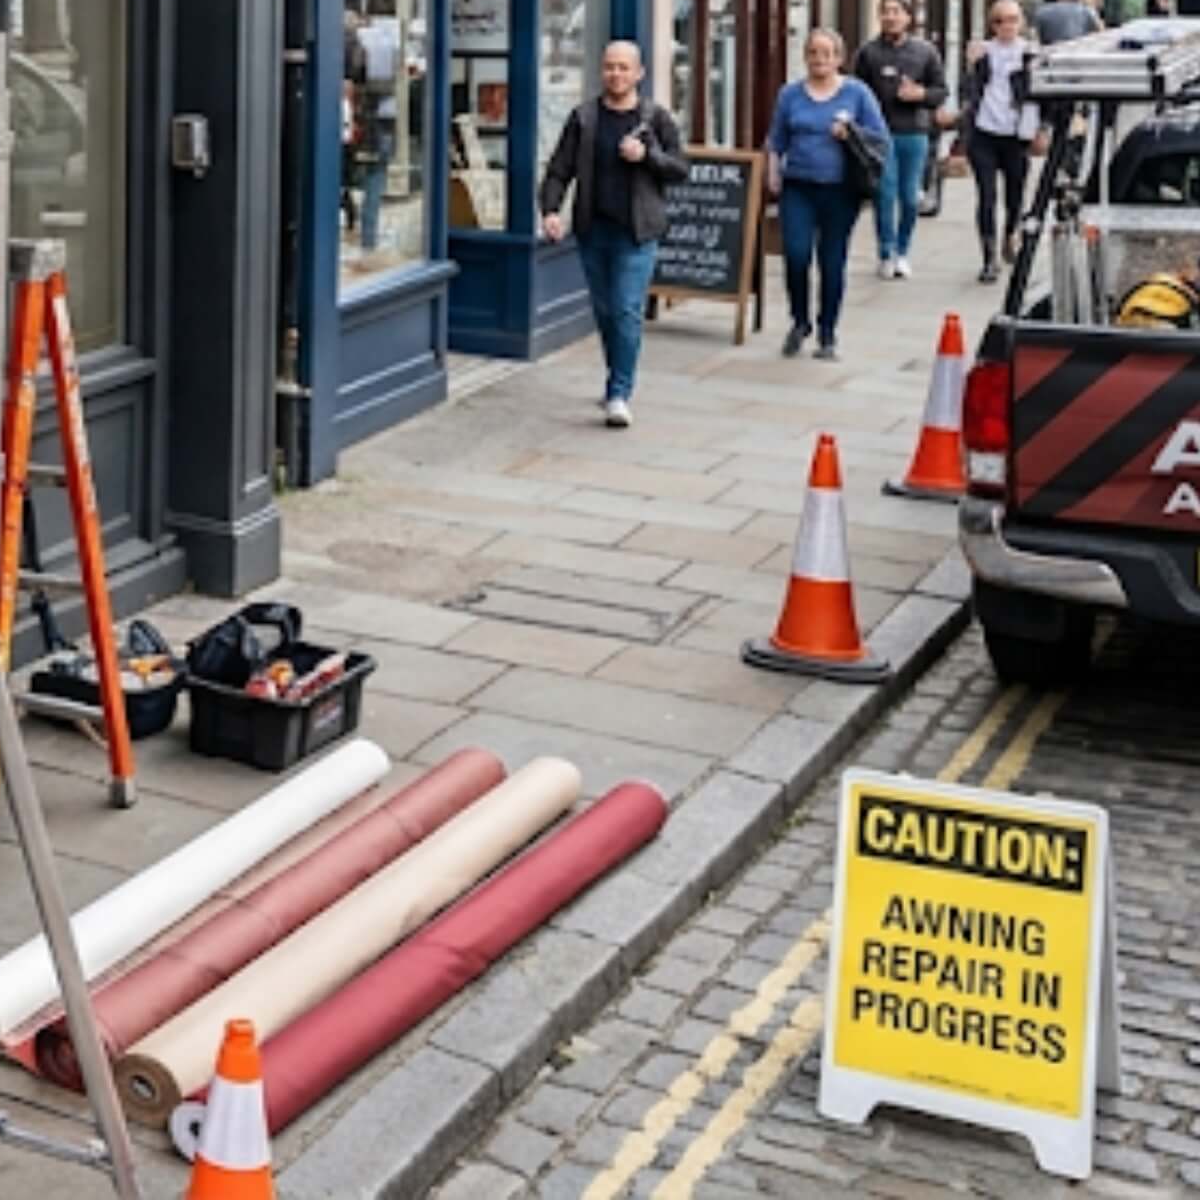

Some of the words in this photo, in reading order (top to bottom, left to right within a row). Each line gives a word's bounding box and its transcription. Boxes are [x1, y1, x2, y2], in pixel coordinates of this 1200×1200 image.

[863, 806, 1080, 883] CAUTION:
[881, 895, 1046, 957] AWNING
[862, 940, 1005, 999] REPAIR
[1021, 971, 1062, 1011] IN
[851, 988, 1067, 1064] PROGRESS
